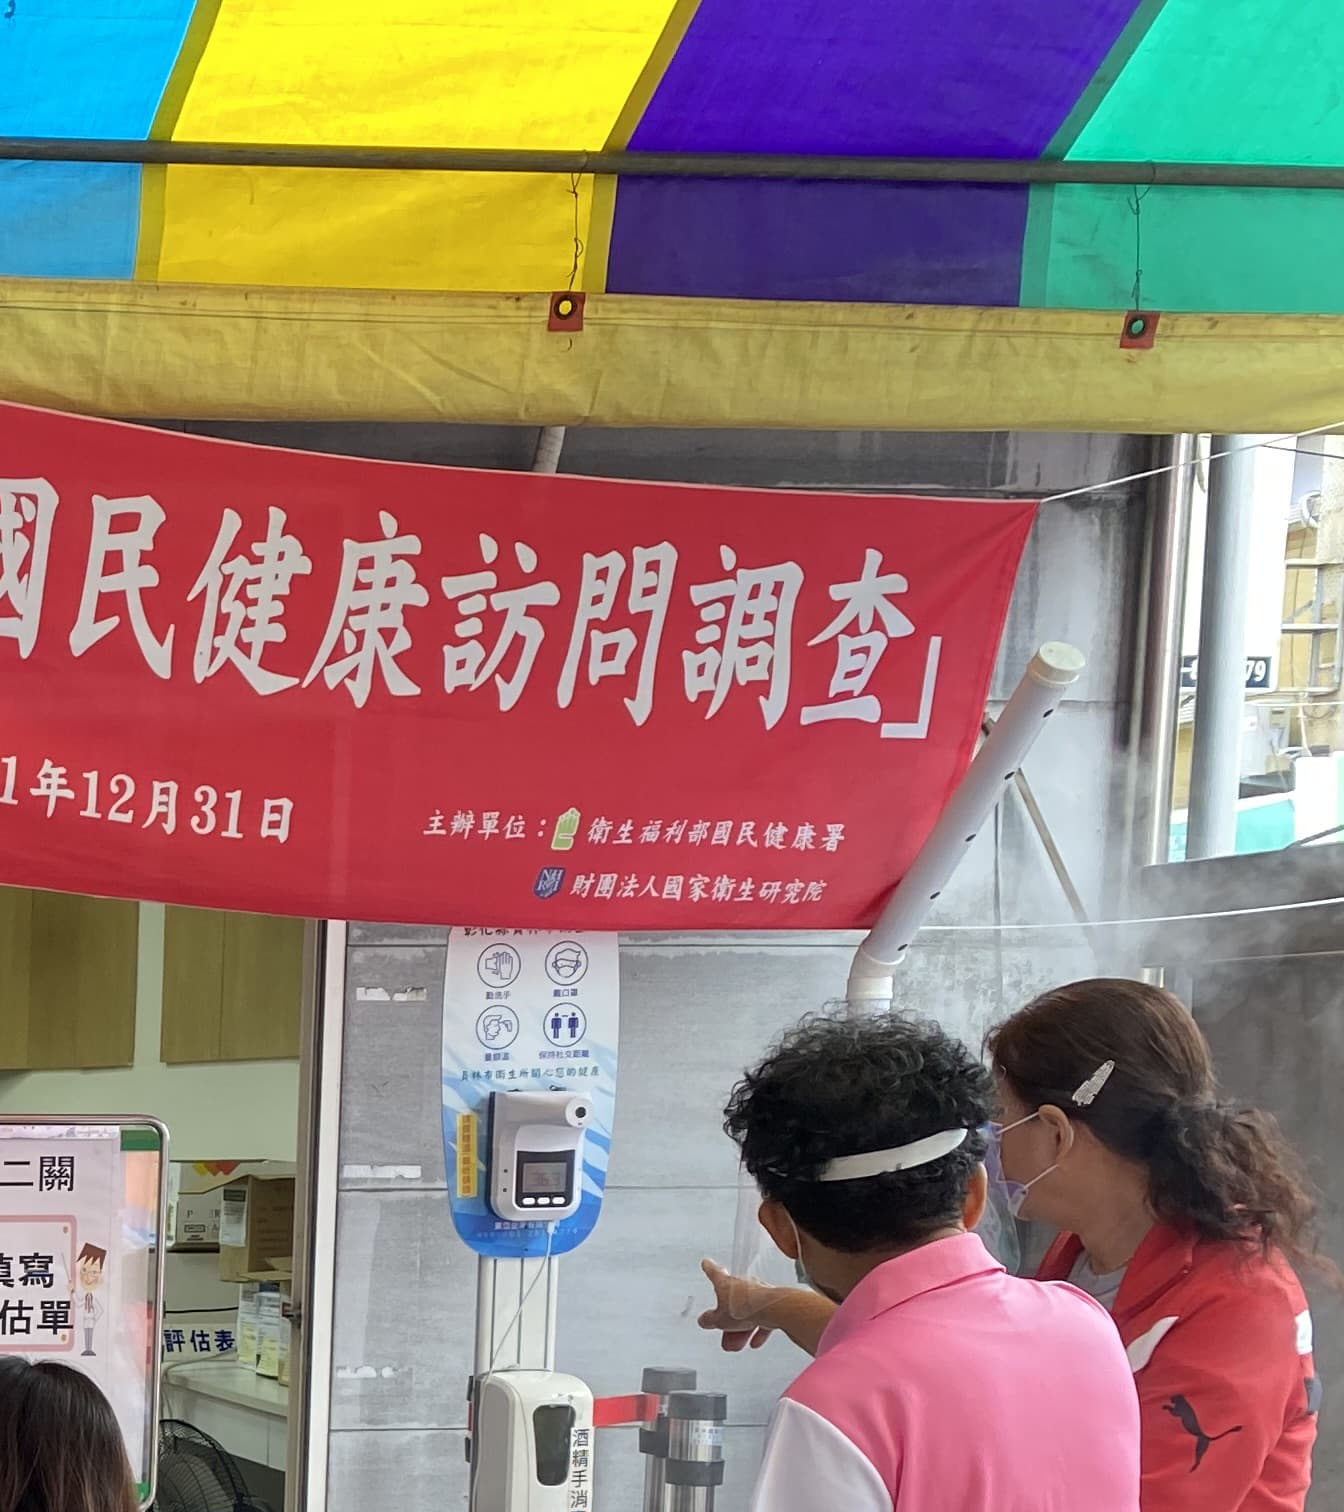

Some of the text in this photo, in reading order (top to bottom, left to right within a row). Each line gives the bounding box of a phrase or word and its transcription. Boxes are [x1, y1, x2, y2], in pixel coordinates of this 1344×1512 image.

[423, 809, 846, 852] 主辦單位： 衛生福利部國民健康署
[570, 873, 828, 905] 財團法人國家衛生研究院
[163, 1329, 236, 1353] 評估表
